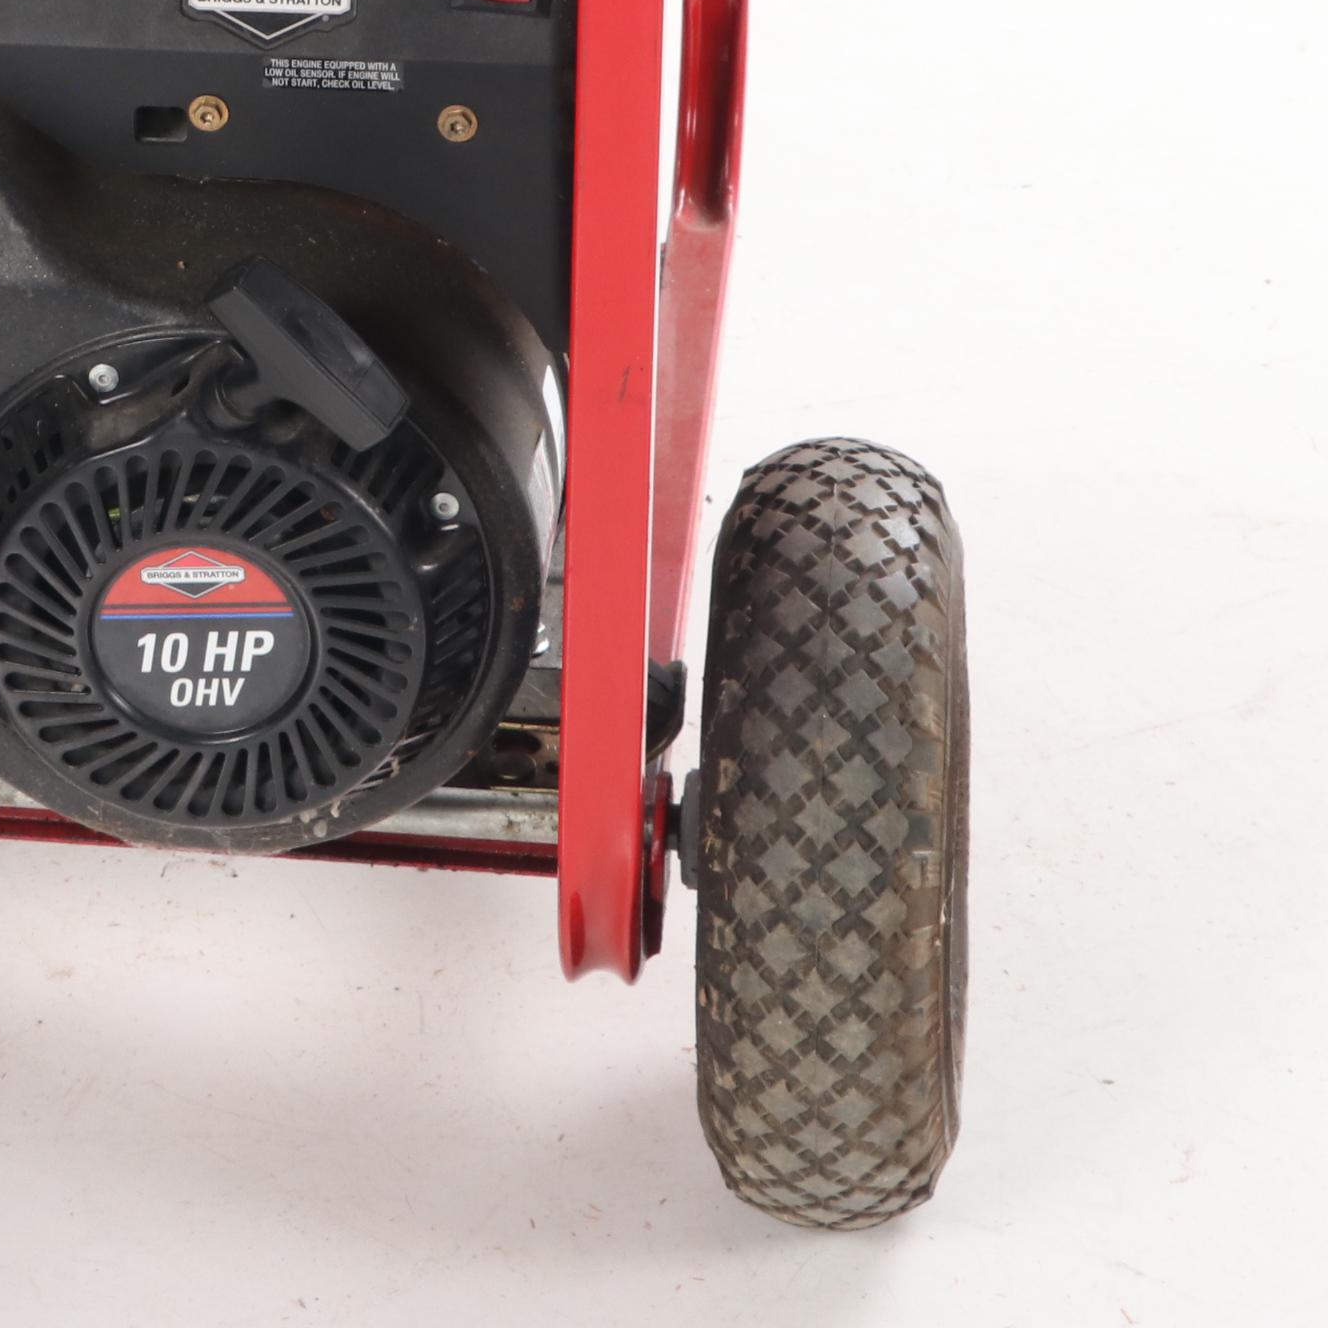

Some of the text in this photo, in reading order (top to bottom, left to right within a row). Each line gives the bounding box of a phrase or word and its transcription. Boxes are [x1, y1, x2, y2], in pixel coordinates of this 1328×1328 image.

[271, 59, 396, 71] THIS ENGINE EQUIPPED WITH A
[264, 68, 400, 81] LOW OIL SENSOR. IF ENGINE WILL
[272, 78, 395, 90] NOT START, CHECK OIL LEVEL.
[146, 570, 239, 579] BRIGGS & STRATTON
[137, 630, 274, 673] 10 HP
[170, 678, 245, 707] OHV
